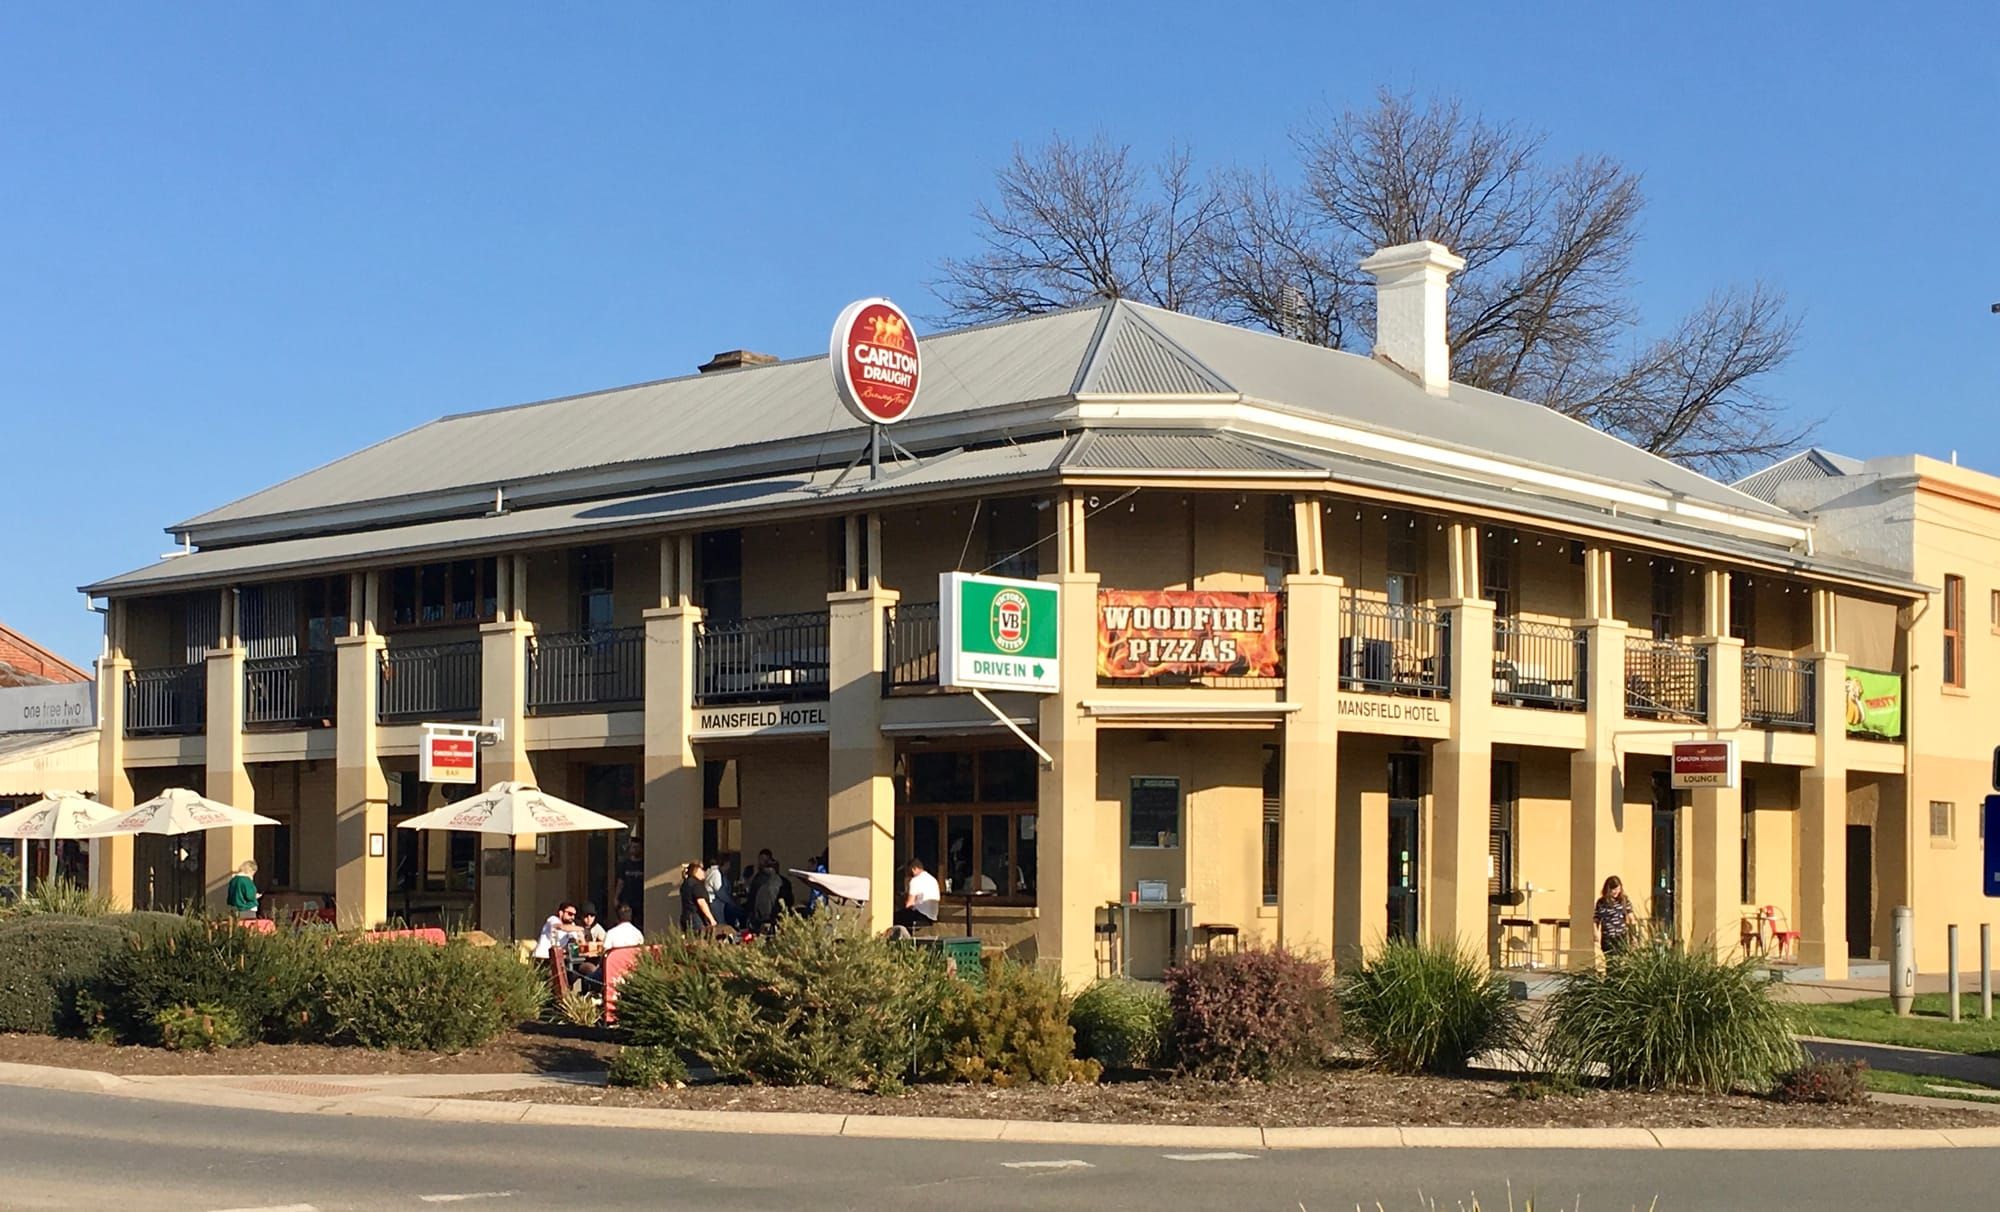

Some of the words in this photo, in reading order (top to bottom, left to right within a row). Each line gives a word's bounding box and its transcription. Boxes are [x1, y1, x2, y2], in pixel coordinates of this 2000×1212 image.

[855, 344, 917, 375] CARLTON
[863, 366, 912, 388] DRAUGHT
[1002, 612, 1019, 628] VB
[1103, 606, 1264, 632] WOODFIRE
[1128, 637, 1237, 662] PIZZA'S
[973, 660, 1011, 676] DRIVE
[1013, 664, 1026, 677] IN
[23, 704, 41, 719] one
[64, 699, 82, 716] two
[701, 711, 777, 729] MANSFIELD
[781, 709, 826, 726] HOTEL
[1338, 699, 1401, 719] MANSFIELD
[1404, 705, 1440, 722] HOTEL
[1683, 775, 1718, 783] LOUNGE
